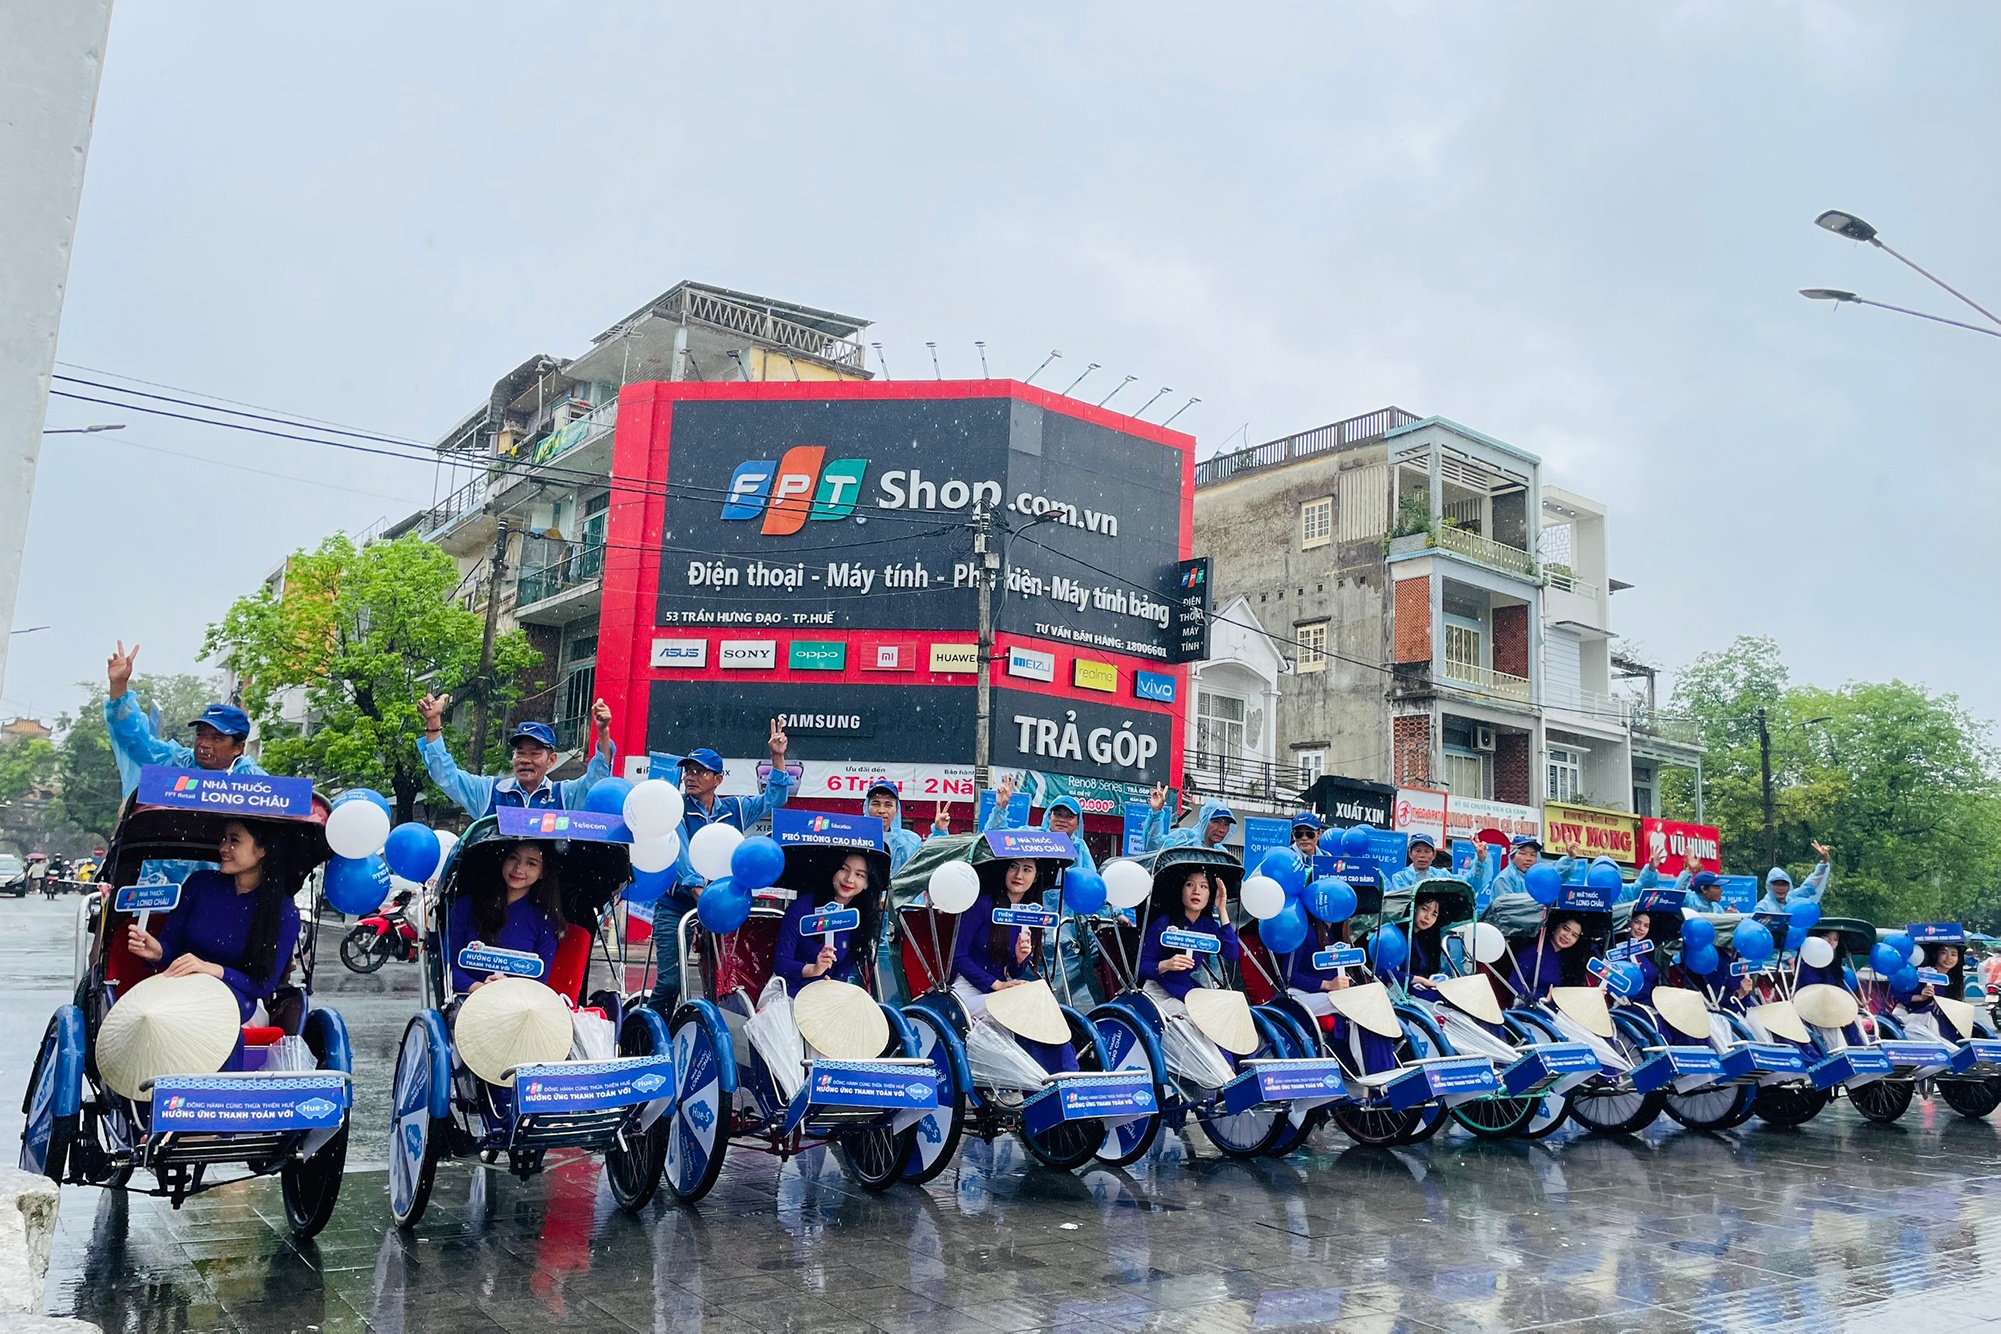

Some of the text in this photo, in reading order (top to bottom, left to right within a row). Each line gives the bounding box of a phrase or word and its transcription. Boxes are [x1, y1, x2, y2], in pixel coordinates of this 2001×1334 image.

[878, 469, 1002, 520] Shop
[687, 561, 739, 591] Điện
[747, 561, 804, 592] thoại
[827, 562, 875, 594] Máy
[884, 562, 928, 588] tính
[1052, 576, 1090, 612] Máy
[1092, 586, 1123, 615] tính
[1128, 594, 1170, 629] bảng
[666, 611, 679, 622] 53
[717, 611, 752, 622] HƯNG
[793, 610, 836, 624] TP.HUẾ
[1182, 627, 1200, 637] MÁY
[1035, 622, 1050, 634] TƯ
[1050, 624, 1071, 639] VẤN
[1073, 628, 1093, 643] BÁN
[1126, 640, 1168, 658] 18006601
[1181, 642, 1200, 652] TÍNH
[659, 648, 700, 658] ASUS
[724, 649, 770, 659] SONY
[1078, 667, 1114, 683] realme
[1141, 680, 1172, 697] vivo
[778, 713, 861, 730] SAMSUNG
[1014, 709, 1158, 770] TRẢ GÓP
[203, 780, 272, 794] NHÀ THUỐC
[827, 775, 842, 791] 6
[925, 778, 974, 795] 2 Nă
[1068, 775, 1123, 793] Reno8 Series
[201, 792, 290, 808] LONG CHÂU
[1335, 800, 1363, 820] XUẤT
[1364, 807, 1384, 826] XỊN
[529, 818, 607, 830] FPT Telecom
[782, 832, 875, 847] PHỔ THÔNG CAO ĐẲNG
[1669, 831, 1717, 861] VŨ HÙNG
[1021, 844, 1044, 852] LONG
[1044, 844, 1066, 853] CHÂU
[1251, 844, 1262, 852] QR
[137, 899, 153, 907] LONG
[153, 897, 170, 906] CHÂU
[466, 953, 492, 962] HƯỞNG
[493, 956, 508, 965] ỨNG
[637, 1077, 660, 1087] Hue-S
[525, 1093, 551, 1101] HƯỞNG
[553, 1092, 569, 1100] ỨNG
[596, 1089, 615, 1098] TOÁN
[618, 1087, 631, 1095] VỚI
[816, 1085, 838, 1093] HƯỞNG
[840, 1086, 853, 1094] ỨNG
[893, 1089, 905, 1097] VỚI
[161, 1109, 294, 1119] HƯỞNG ỨNG THANH TOÁN VỚI
[302, 1103, 329, 1112] Hue-S
[692, 1106, 711, 1123] Hue-S
[921, 1118, 938, 1139] ue-S
